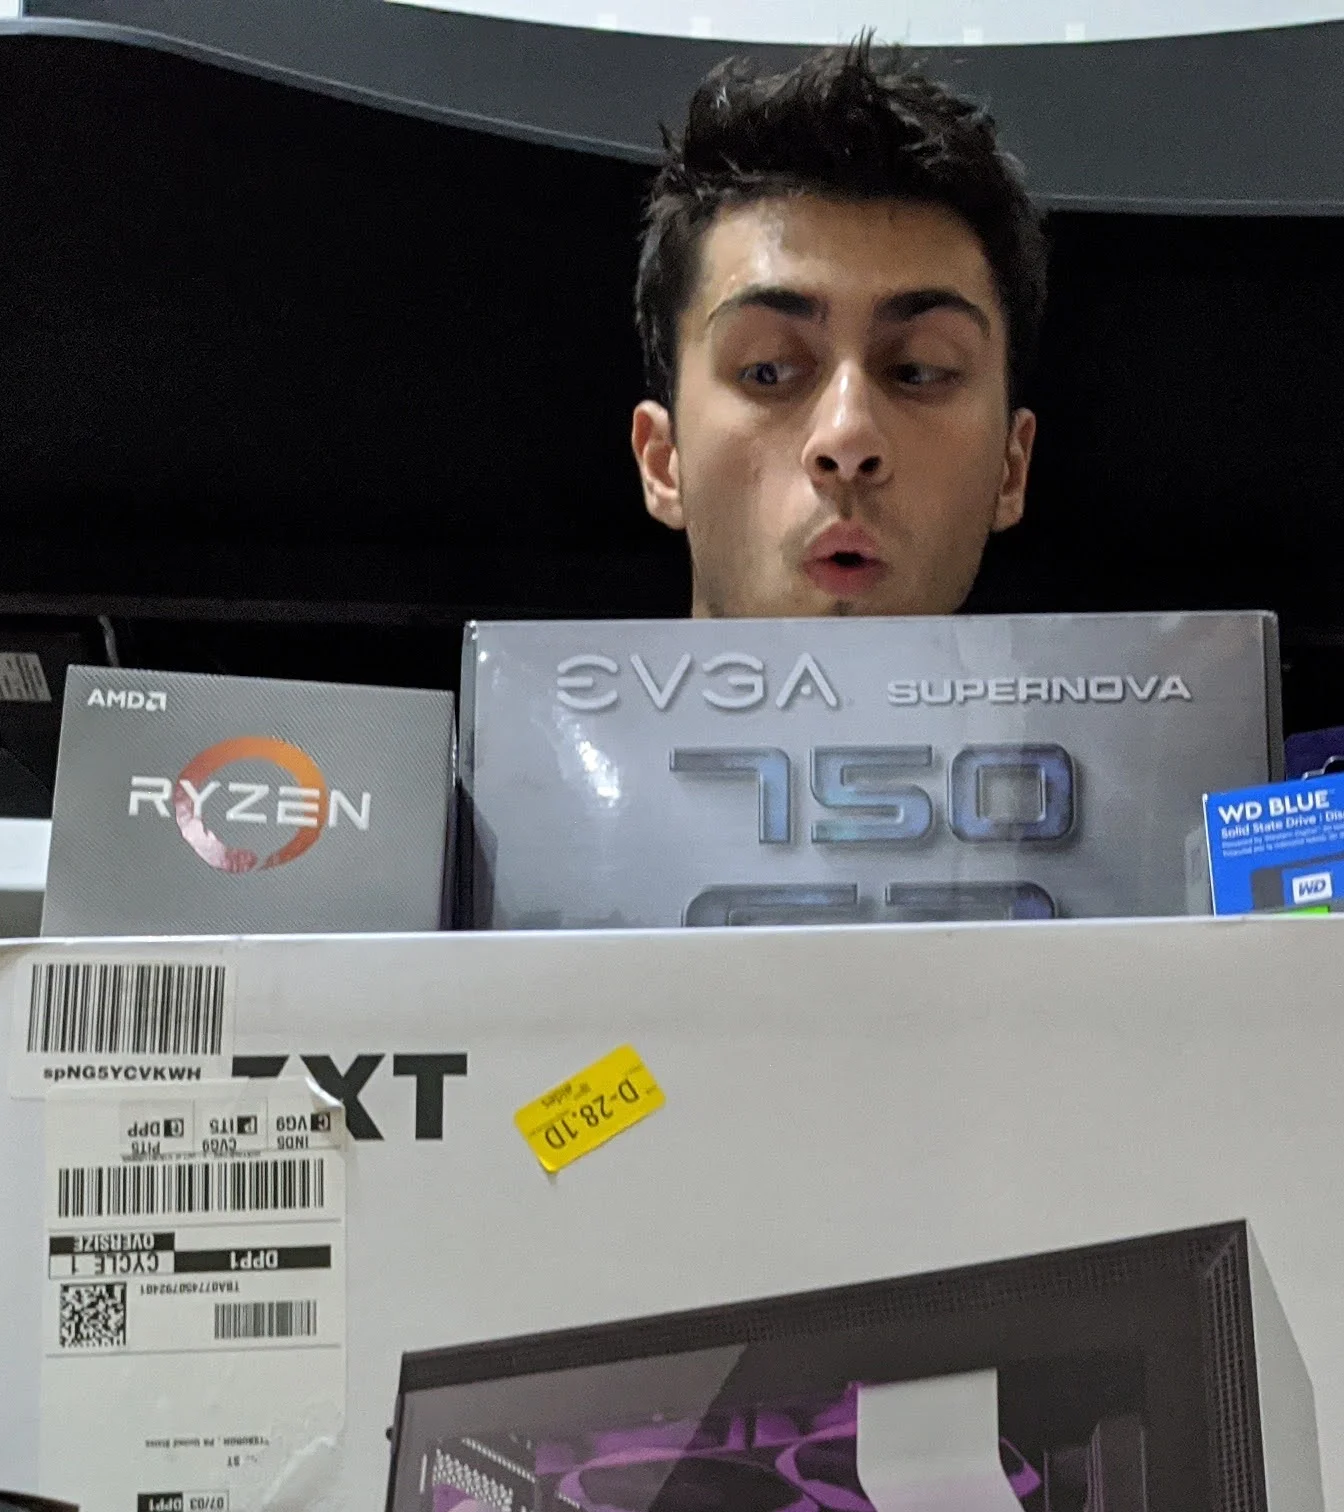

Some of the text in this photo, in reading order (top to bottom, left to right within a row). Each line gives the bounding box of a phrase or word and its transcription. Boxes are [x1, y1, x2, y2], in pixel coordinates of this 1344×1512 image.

[556, 652, 1192, 710] EVGA SUPERNOVA
[87, 688, 145, 710] AMD
[128, 775, 371, 830] RYZEN
[668, 743, 1076, 845] 750
[1218, 790, 1330, 824] WD BLUE
[1221, 825, 1250, 840] Solid
[1253, 820, 1284, 836] State
[1285, 815, 1317, 831] Drive
[1297, 878, 1327, 898] WD
[544, 1077, 641, 1152] D-28.1D
[127, 1120, 161, 1139] DPP
[74, 1233, 155, 1251] OVERSIZE
[94, 1253, 159, 1275] CYCLE
[230, 1249, 279, 1270] DPP1
[189, 1496, 225, 1511] 07/03
